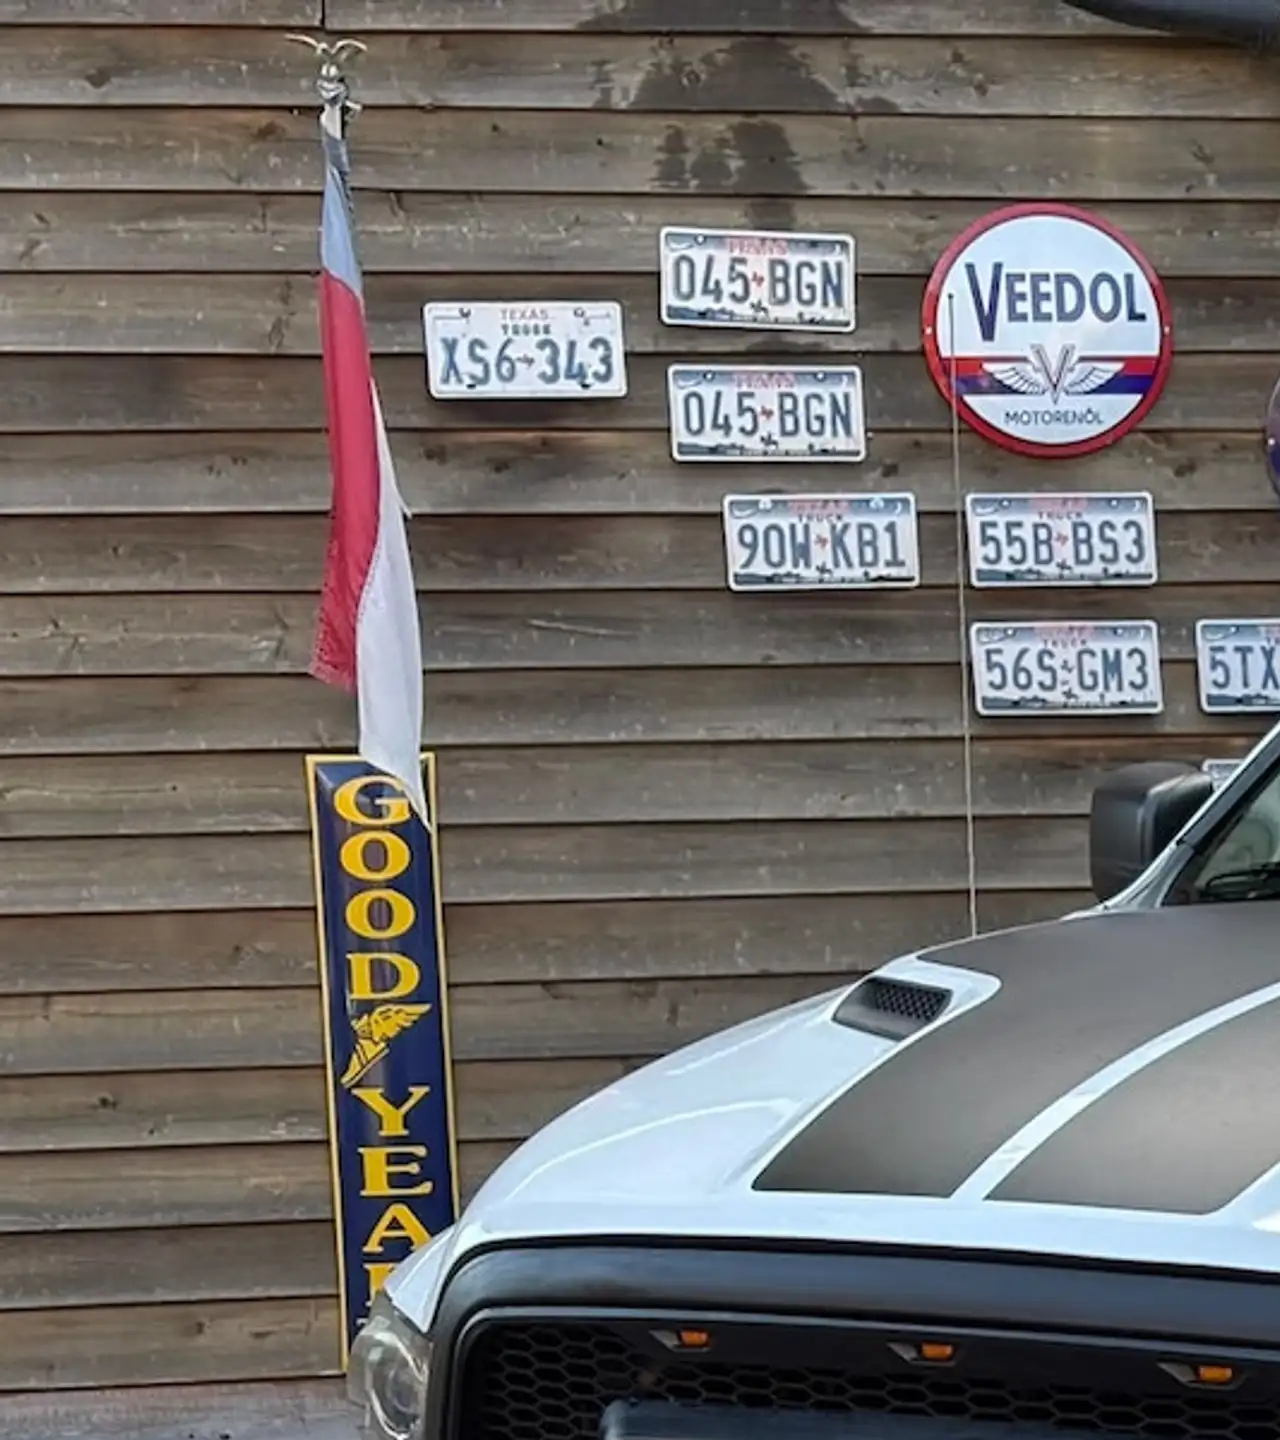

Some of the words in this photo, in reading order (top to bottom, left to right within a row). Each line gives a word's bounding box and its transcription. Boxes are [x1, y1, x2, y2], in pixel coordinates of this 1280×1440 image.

[673, 254, 750, 303] 045
[768, 259, 844, 307] BGN
[965, 262, 1147, 342] VEEDOL
[499, 307, 549, 320] TEXAS
[440, 336, 516, 385] XS6
[535, 336, 613, 385] 343
[684, 390, 758, 437] 045
[777, 391, 852, 438] BGN
[737, 522, 812, 570] 90W
[829, 520, 906, 569] KB1
[979, 520, 1054, 566] 55B
[1072, 519, 1146, 566] BS3
[985, 647, 1057, 691] 56S
[1077, 647, 1148, 692] GM3
[1208, 646, 1280, 690] 5TX
